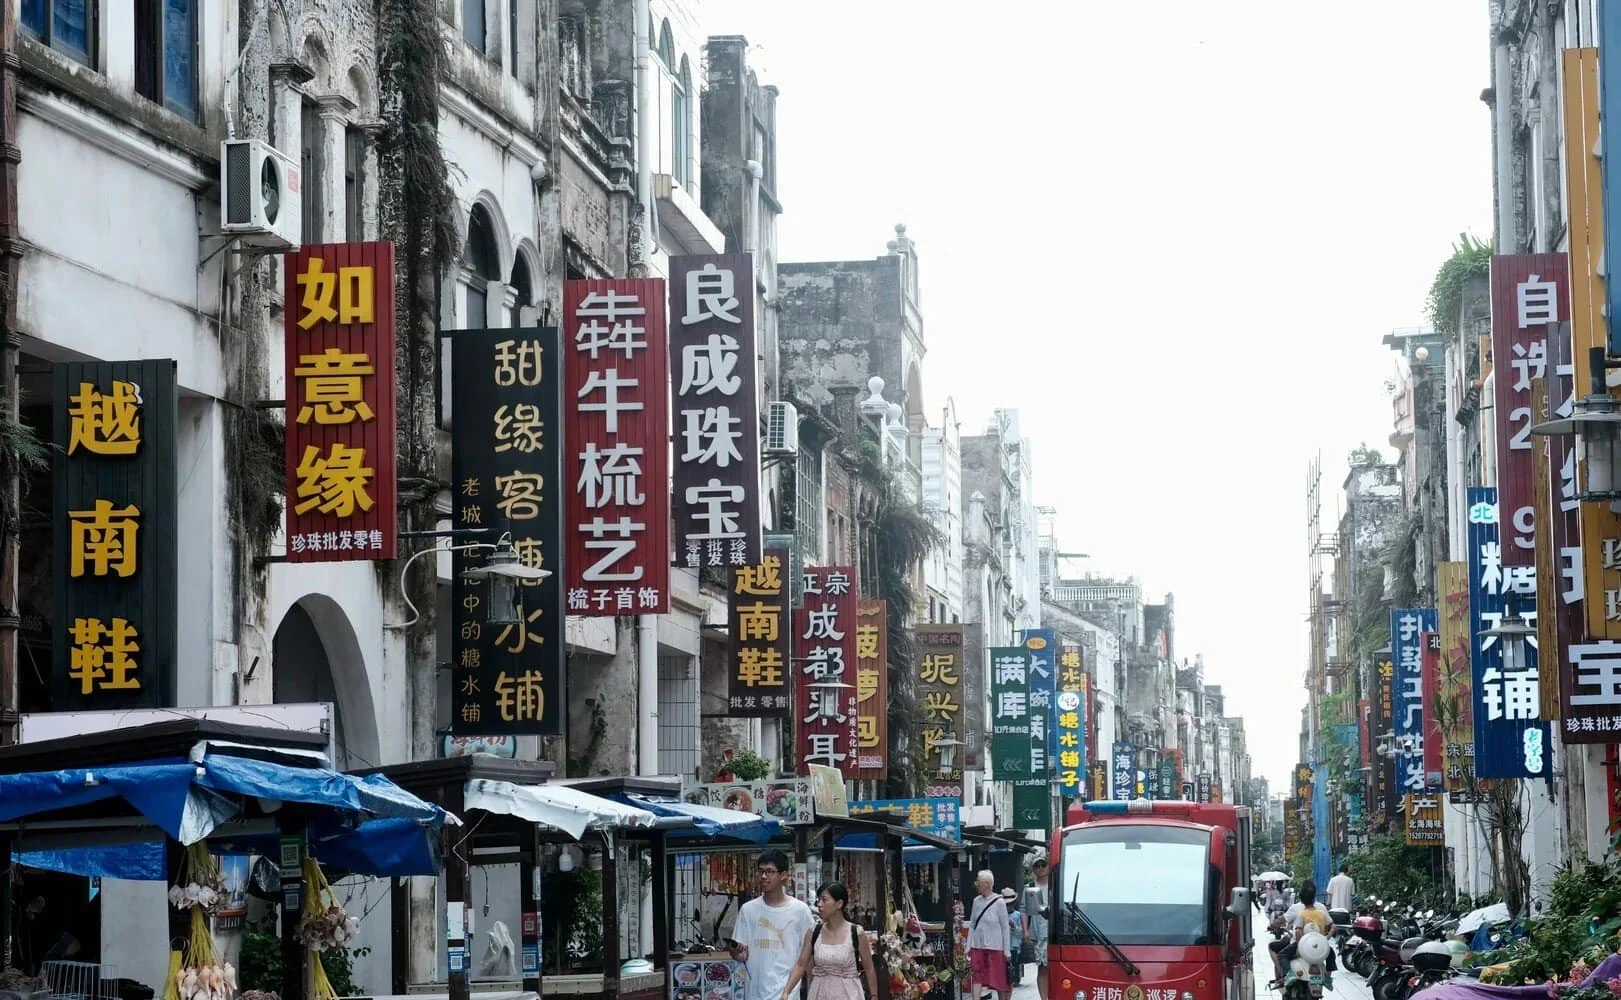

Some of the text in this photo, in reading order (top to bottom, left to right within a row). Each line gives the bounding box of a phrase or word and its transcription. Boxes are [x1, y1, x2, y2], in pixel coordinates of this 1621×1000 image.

[294, 257, 376, 519] 如意缘
[680, 263, 747, 540] 良成珠宝
[575, 289, 648, 583] 犇牛梳艺
[67, 380, 142, 695] 越南鞋
[291, 530, 384, 553] 珍珠批发零售
[568, 587, 660, 611] 梳子首饰
[803, 573, 851, 596] 正宗
[735, 555, 784, 688] 越南鞋
[994, 656, 1026, 720] 满库
[1411, 793, 1438, 816] 产
[1092, 987, 1122, 1000] 消防
